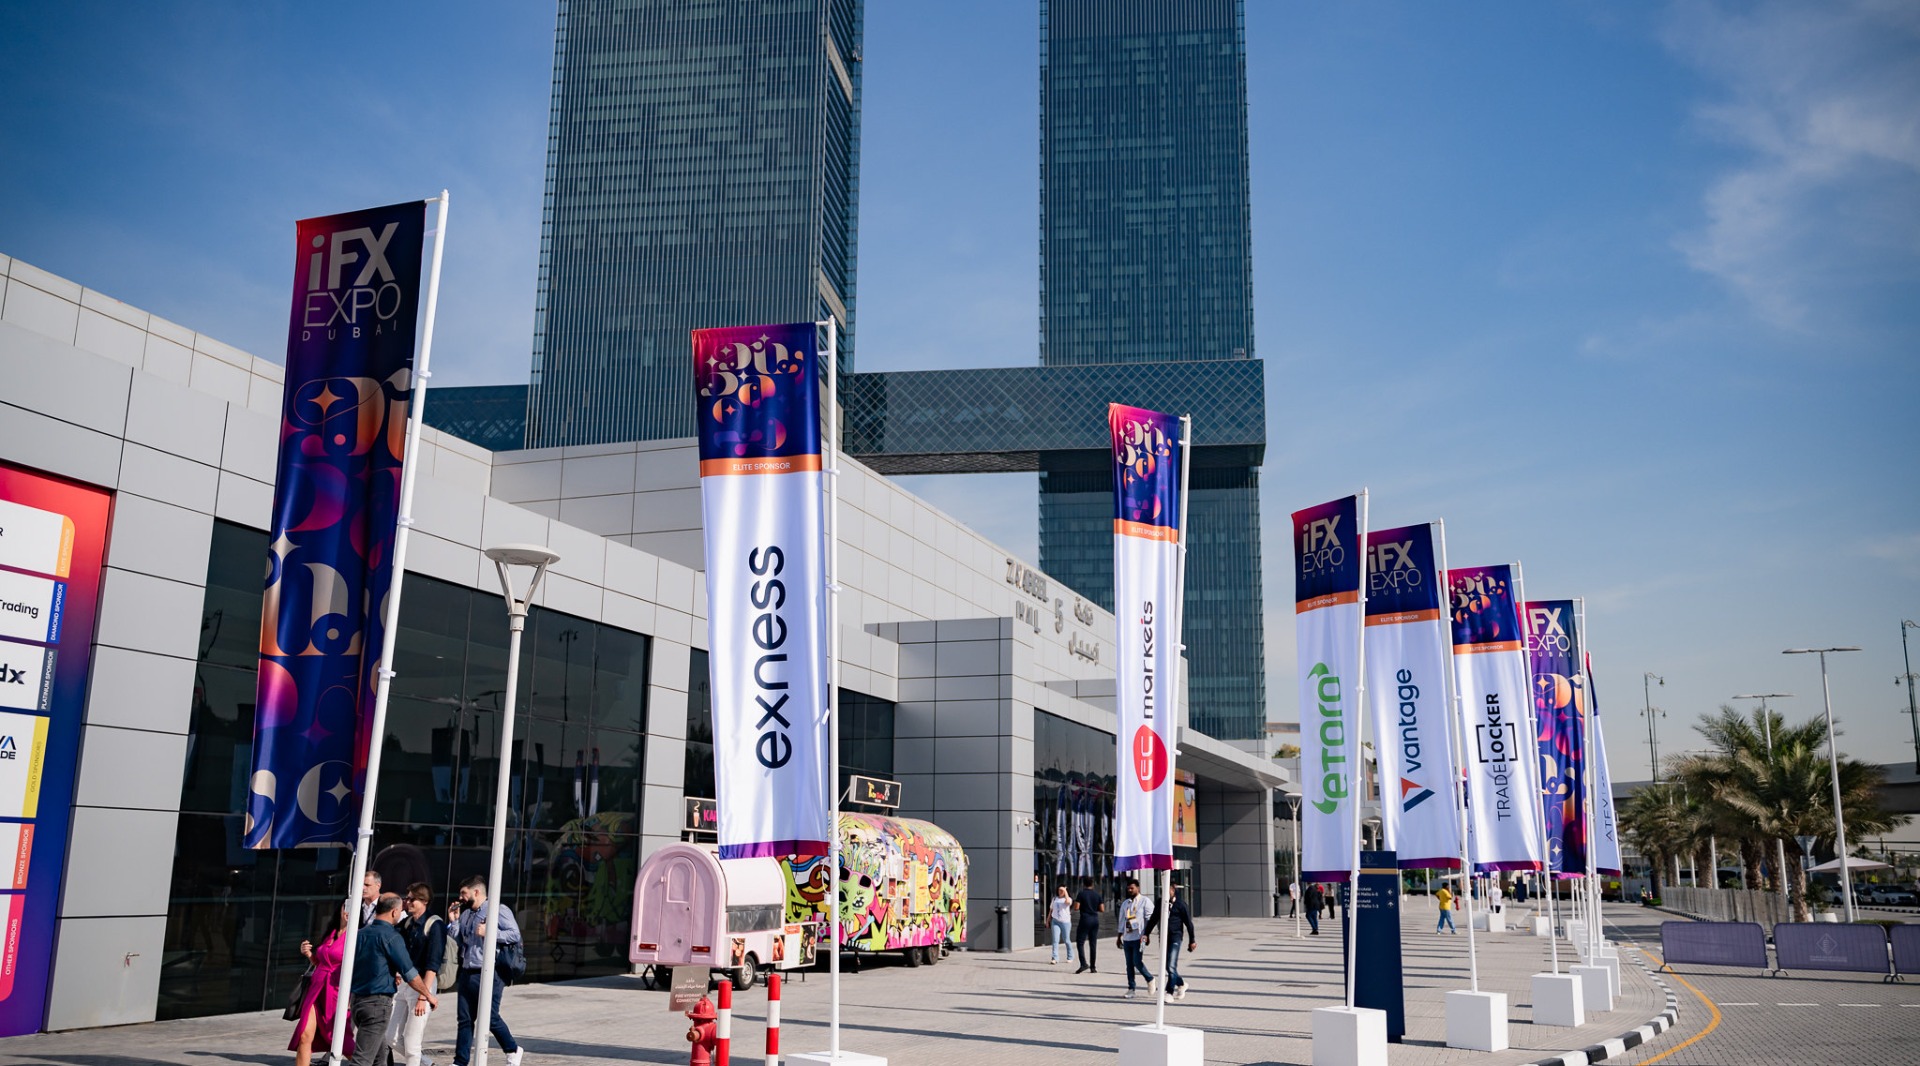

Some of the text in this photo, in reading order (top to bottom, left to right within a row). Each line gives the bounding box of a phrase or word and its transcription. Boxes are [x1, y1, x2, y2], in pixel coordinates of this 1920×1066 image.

[308, 222, 400, 291] iFX
[304, 282, 401, 327] EXPO
[302, 319, 397, 341] DUBAI
[754, 462, 790, 471] SPONSOR
[1303, 514, 1341, 554] iFX
[1303, 546, 1345, 573] EXPO
[1303, 566, 1344, 580] DUBAI
[1368, 540, 1416, 573] iFX
[1370, 568, 1421, 590] EXPO
[1372, 587, 1422, 596] DUBAI
[0, 599, 39, 619] rading
[51, 584, 64, 640] DIAMOND SPONSOR
[1055, 598, 1064, 634] 5
[1526, 607, 1566, 635] FX
[748, 545, 792, 769] exness
[1140, 600, 1153, 719] markets
[1528, 634, 1570, 652] EXPO
[41, 651, 54, 709] PLATINUM SPONSOR
[1396, 668, 1421, 773] vantage
[1485, 693, 1512, 822] TRADELOCKER
[30, 775, 38, 793] GOLD
[17, 829, 29, 884] BRONZE SPONSOR
[5, 919, 18, 975] OTHER SPONSORS
